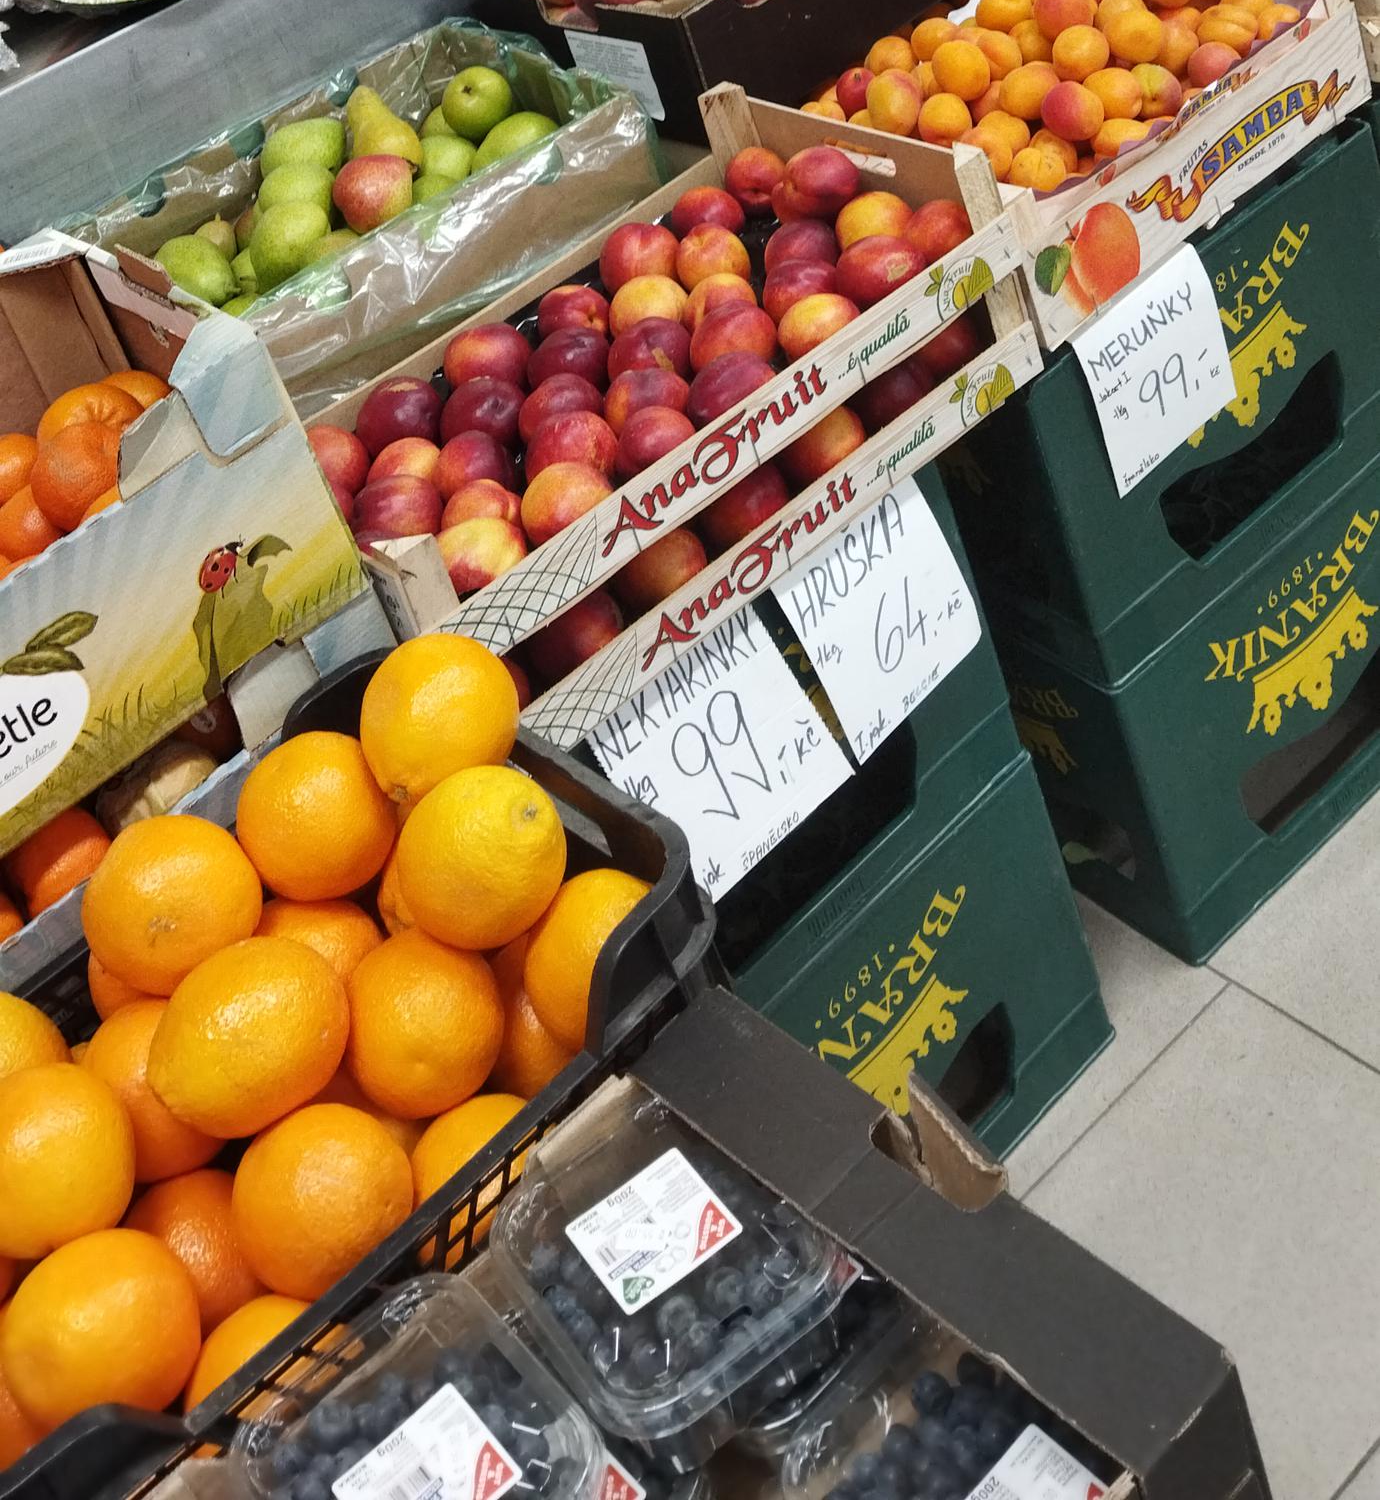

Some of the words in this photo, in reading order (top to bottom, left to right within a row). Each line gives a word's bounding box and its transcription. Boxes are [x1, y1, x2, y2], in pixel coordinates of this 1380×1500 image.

[1181, 75, 1232, 121] SAMBA
[1201, 87, 1304, 184] SAMBA
[1178, 139, 1210, 183] FRUTAS
[1237, 147, 1266, 172] DESDE
[1087, 282, 1193, 382] MERUŇKY
[791, 493, 904, 638] HRUŠKA
[25, 739, 58, 770] future
[606, 1185, 635, 1209] 200g
[376, 1430, 407, 1456] 200g
